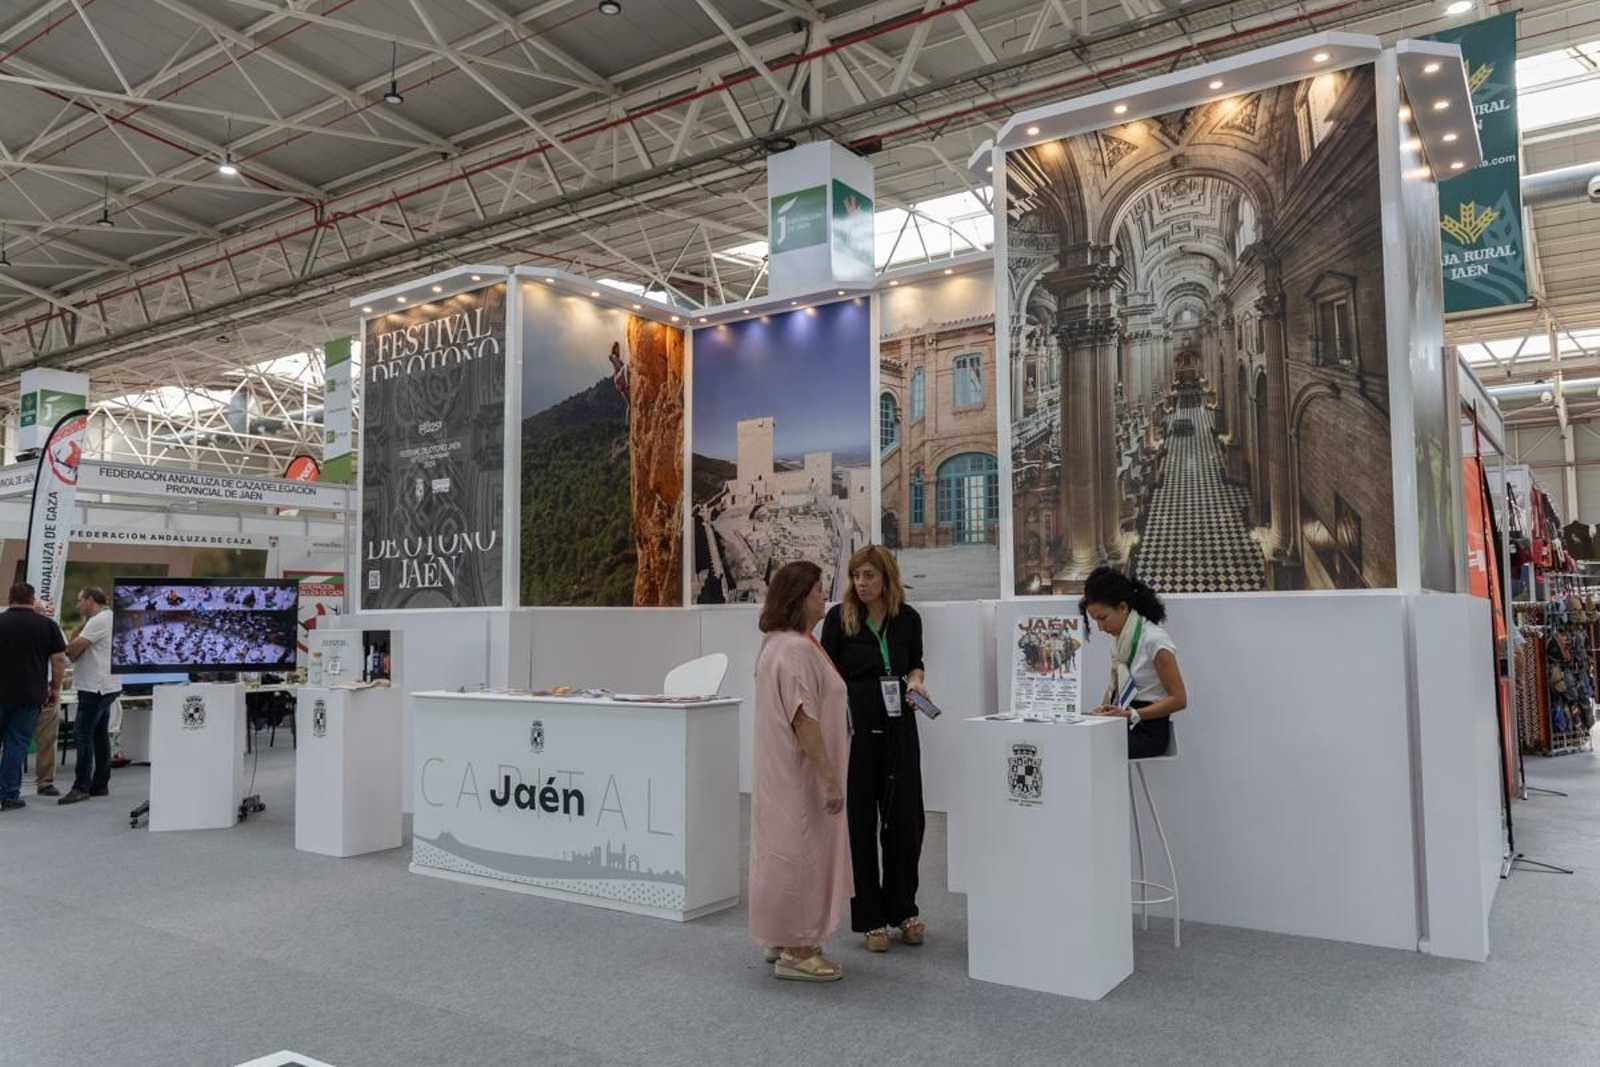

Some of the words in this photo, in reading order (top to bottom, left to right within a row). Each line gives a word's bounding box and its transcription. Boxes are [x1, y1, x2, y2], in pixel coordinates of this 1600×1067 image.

[1464, 244, 1516, 263] RURAL
[377, 307, 492, 363] FESTIVAL
[166, 484, 223, 497] PROVINCIAL
[225, 490, 238, 498] DE
[168, 473, 220, 488] ANDALUZA
[221, 479, 235, 489] DE
[46, 491, 58, 521] CAZA
[45, 523, 56, 539] DE
[151, 534, 209, 543] ANDALUZA
[211, 536, 223, 544] DE
[226, 537, 253, 545] CAZA
[41, 542, 56, 601] ANDALUZA
[399, 553, 458, 589] JAÉN
[421, 757, 675, 837] CAPITAL
[490, 774, 585, 817] Jaén
